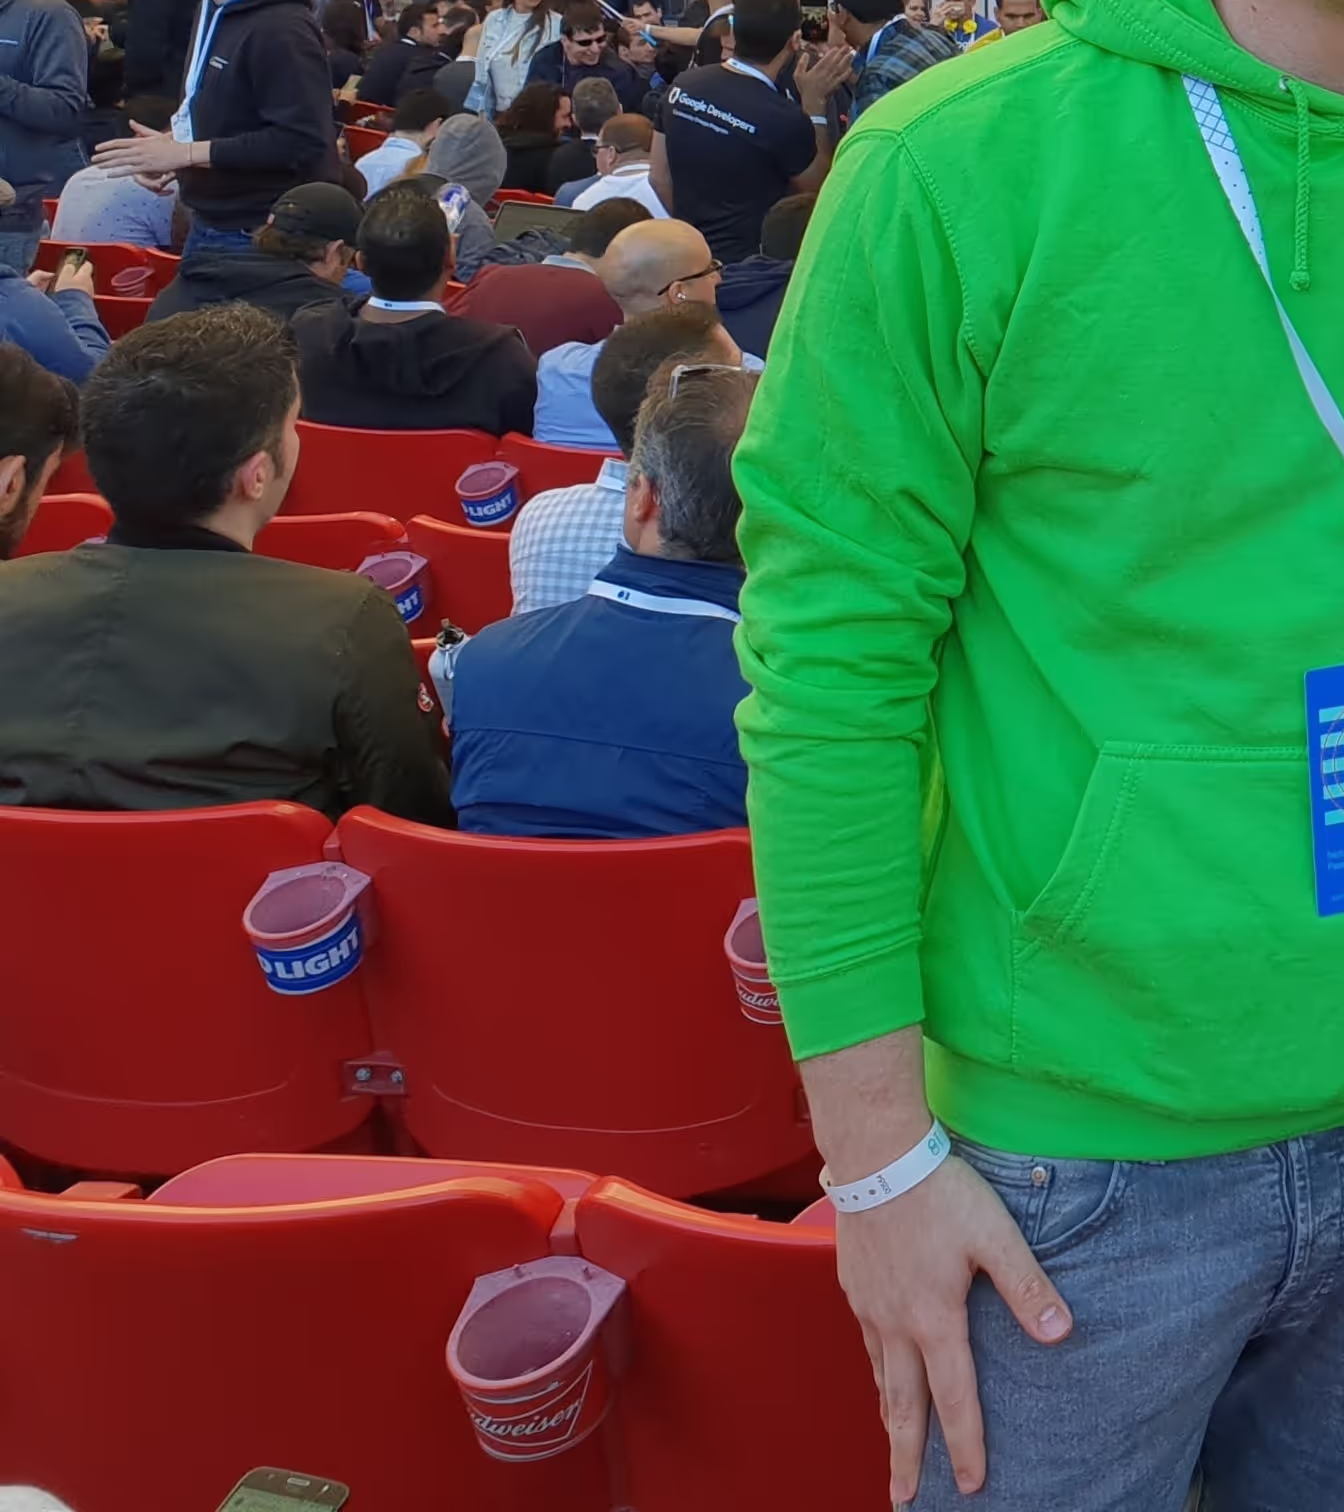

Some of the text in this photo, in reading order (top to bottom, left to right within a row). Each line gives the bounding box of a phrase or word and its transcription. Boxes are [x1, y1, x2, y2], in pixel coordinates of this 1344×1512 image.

[679, 93, 707, 112] Google
[707, 104, 756, 134] Developers
[468, 494, 512, 516] LIGHT
[275, 928, 359, 979] LIGHT
